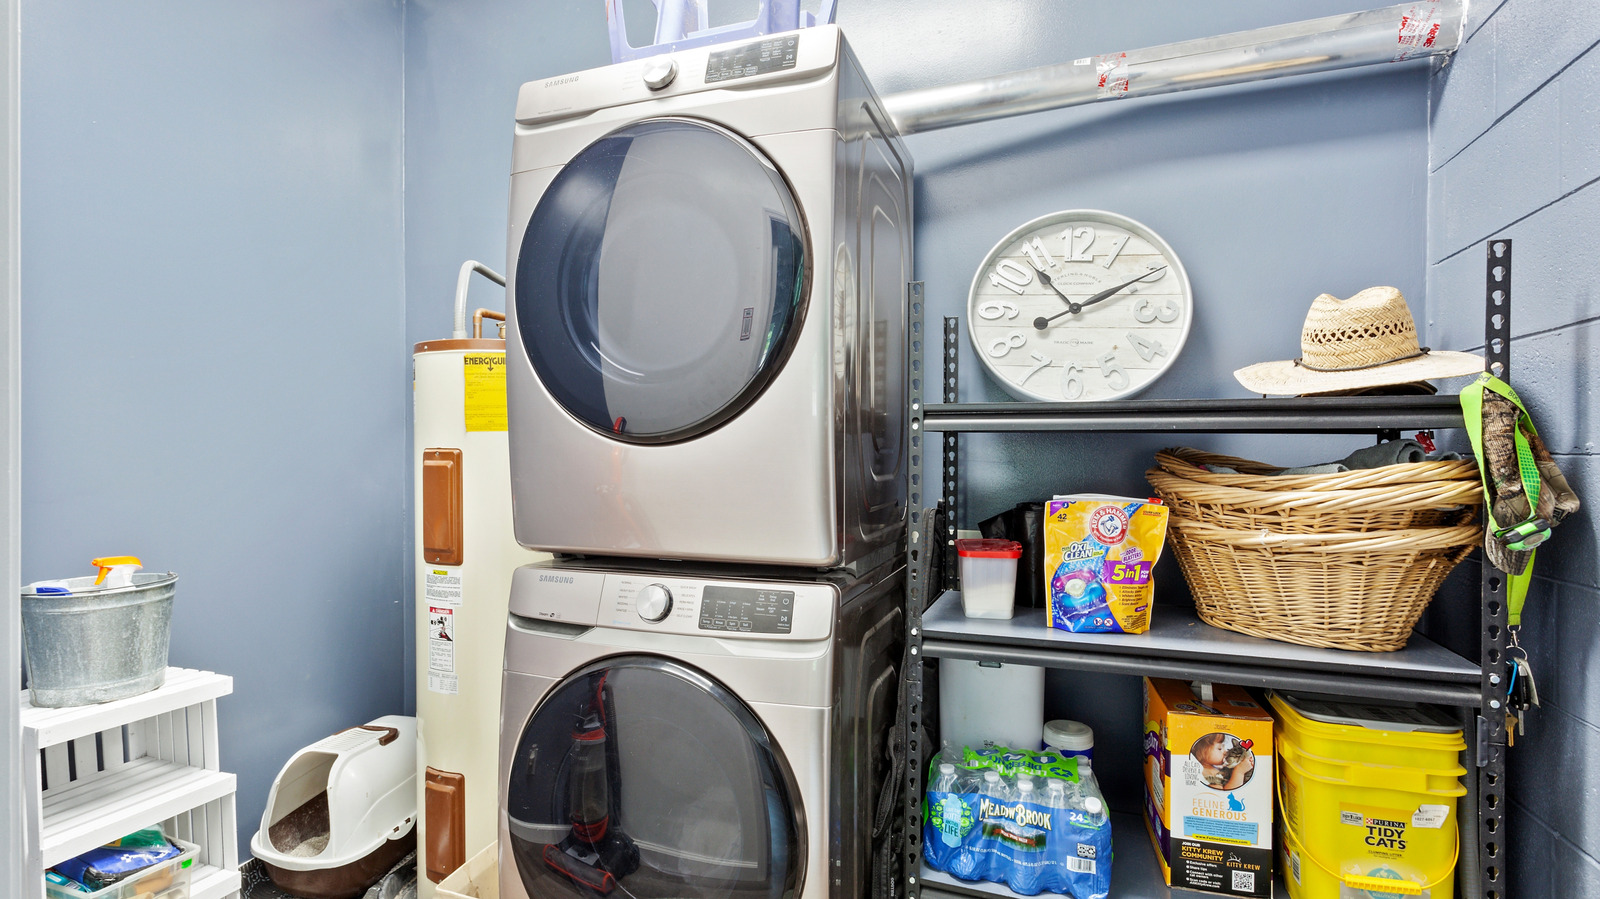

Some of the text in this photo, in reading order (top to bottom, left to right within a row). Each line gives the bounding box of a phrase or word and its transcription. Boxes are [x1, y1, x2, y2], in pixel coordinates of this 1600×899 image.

[544, 76, 580, 88] SAMSUNG
[1060, 226, 1095, 262] 12
[1103, 234, 1130, 269] 1
[1021, 236, 1056, 272] 11
[988, 259, 1033, 295] 10
[1120, 261, 1166, 294] 2
[978, 301, 1019, 320] 9
[1133, 299, 1179, 323] 3
[988, 331, 1027, 358] 8
[1126, 331, 1168, 362] 4
[1017, 351, 1052, 386] 7
[1096, 352, 1129, 391] 5
[1061, 360, 1083, 400] 6
[1106, 508, 1128, 529] HAMMER
[1065, 548, 1093, 560] CLEAN
[1070, 542, 1087, 552] OXI
[539, 575, 574, 584] SAMSUNG
[1193, 798, 1225, 810] FELINE
[1069, 812, 1083, 822] 24
[1192, 807, 1247, 821] GENEROUS
[1374, 819, 1405, 828] PURINA
[945, 824, 958, 837] LIFE
[1366, 825, 1405, 839] TIDY
[1365, 836, 1406, 849] CATS
[1181, 851, 1223, 861] COMMUNITY
